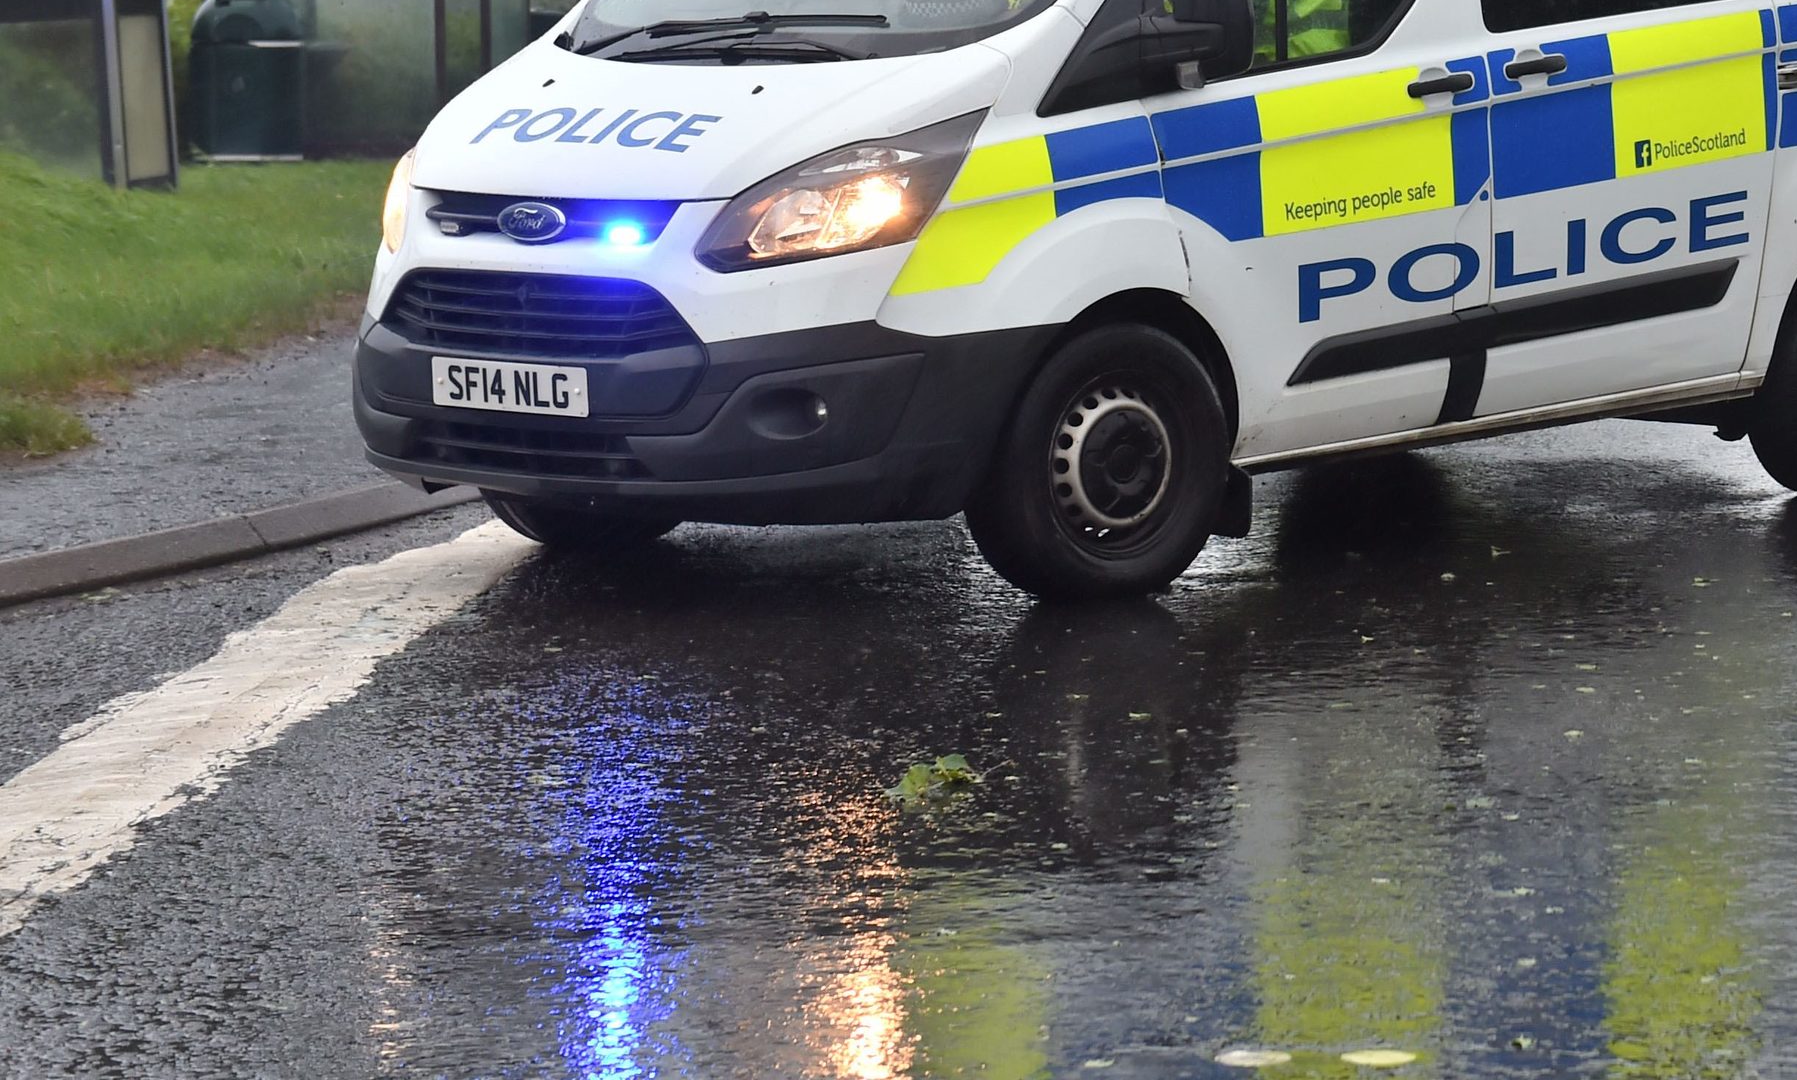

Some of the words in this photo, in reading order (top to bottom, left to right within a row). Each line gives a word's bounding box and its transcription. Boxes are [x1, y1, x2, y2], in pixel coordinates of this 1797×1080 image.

[469, 107, 724, 153] POLICE
[1654, 128, 1747, 160] PoliceScotland
[508, 207, 547, 230] Ford
[1284, 197, 1348, 221] Keeping
[1352, 187, 1403, 214] people
[1407, 181, 1436, 202] safe
[1299, 190, 1750, 323] POLICE
[448, 365, 506, 404] SF14
[514, 370, 569, 409] NLG
